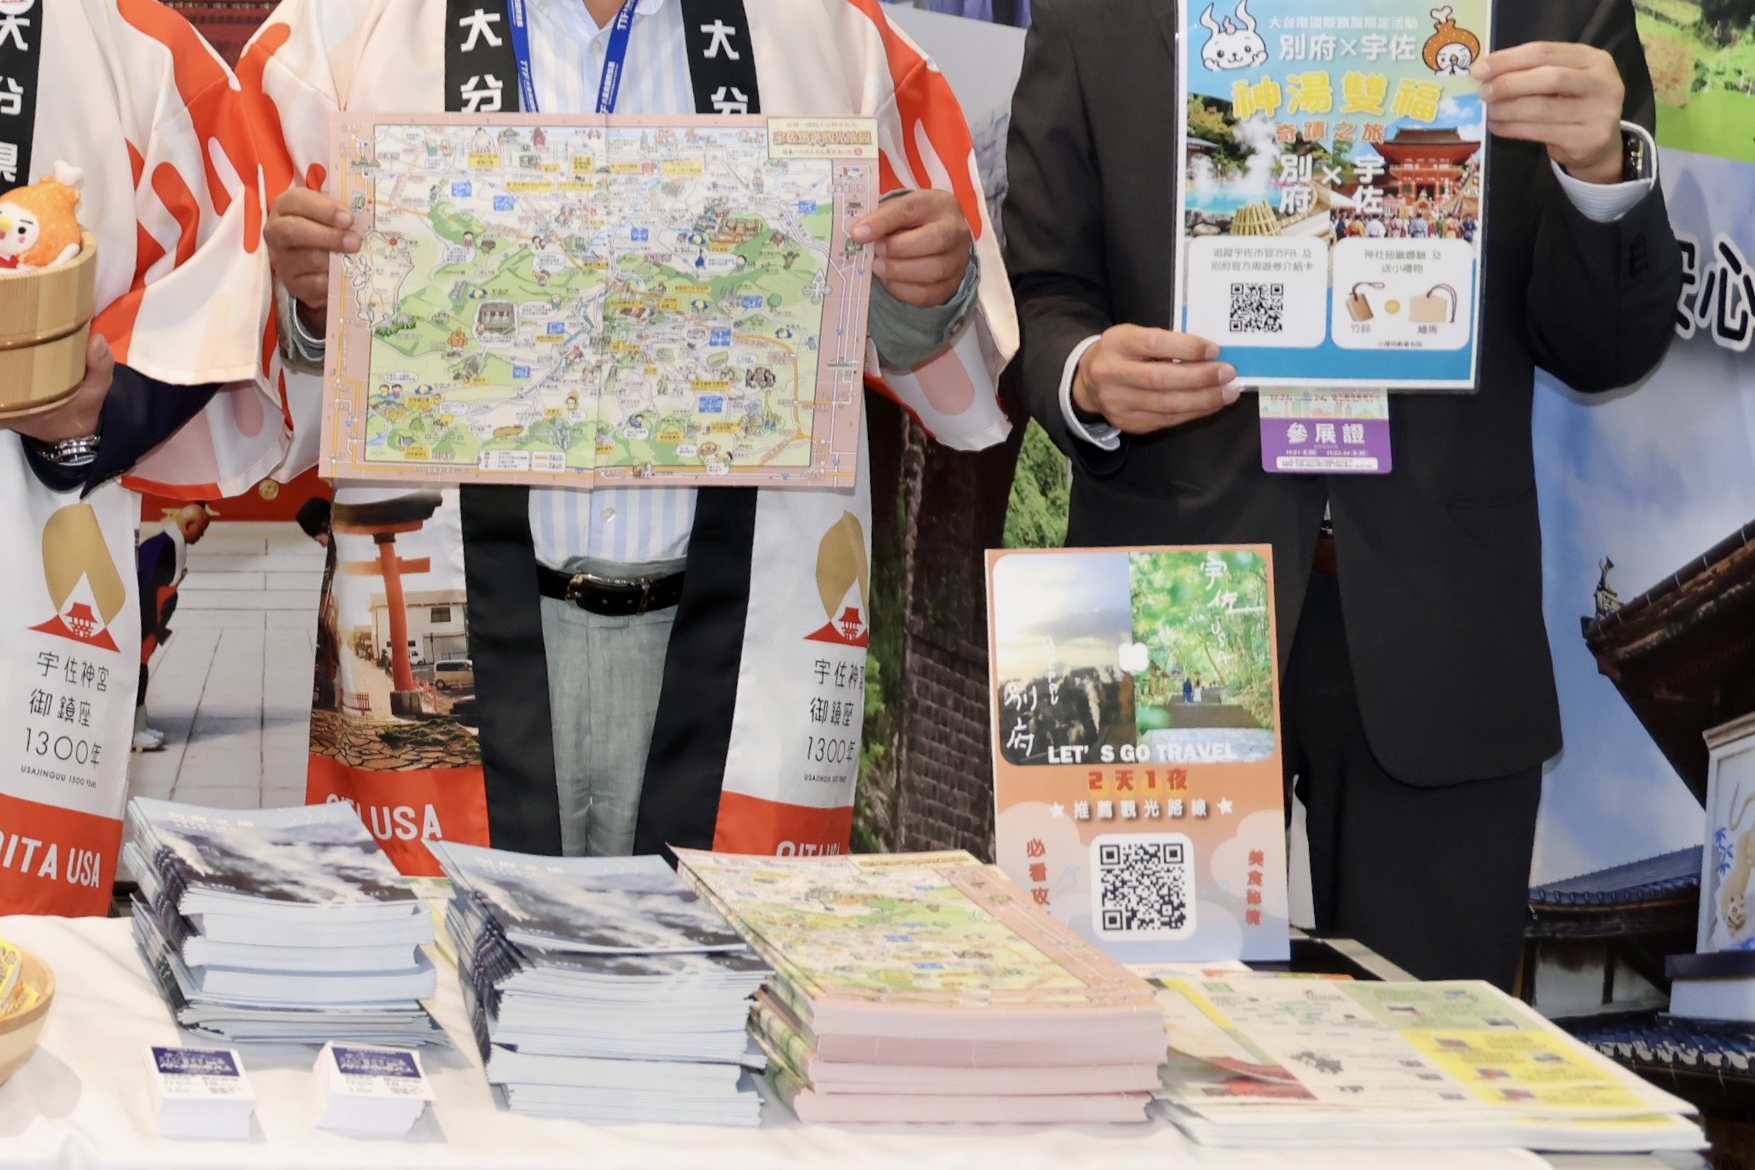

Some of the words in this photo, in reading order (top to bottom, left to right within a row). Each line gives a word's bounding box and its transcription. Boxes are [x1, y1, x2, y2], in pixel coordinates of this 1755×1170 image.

[459, 8, 504, 114] 大分
[1231, 69, 1444, 123] 神湯雙福
[1275, 120, 1386, 145] 奇蹟之旅
[1279, 154, 1314, 215] 別府
[1352, 153, 1386, 215] 宇佐
[1286, 422, 1366, 445] 參展證
[1200, 560, 1238, 610] 宇佐
[36, 650, 110, 693] 宇佐神宮
[28, 687, 92, 729] 御鎮座
[1004, 681, 1038, 757] 別府
[23, 727, 102, 769] 1300年
[1119, 744, 1151, 763] GO
[1155, 742, 1237, 762] TRAVEL
[20, 764, 67, 782] USAJINGUU
[1089, 768, 1189, 791] 2天1夜
[371, 802, 443, 842] USA
[65, 850, 102, 889] USA
[1026, 837, 1052, 913] 必看攻
